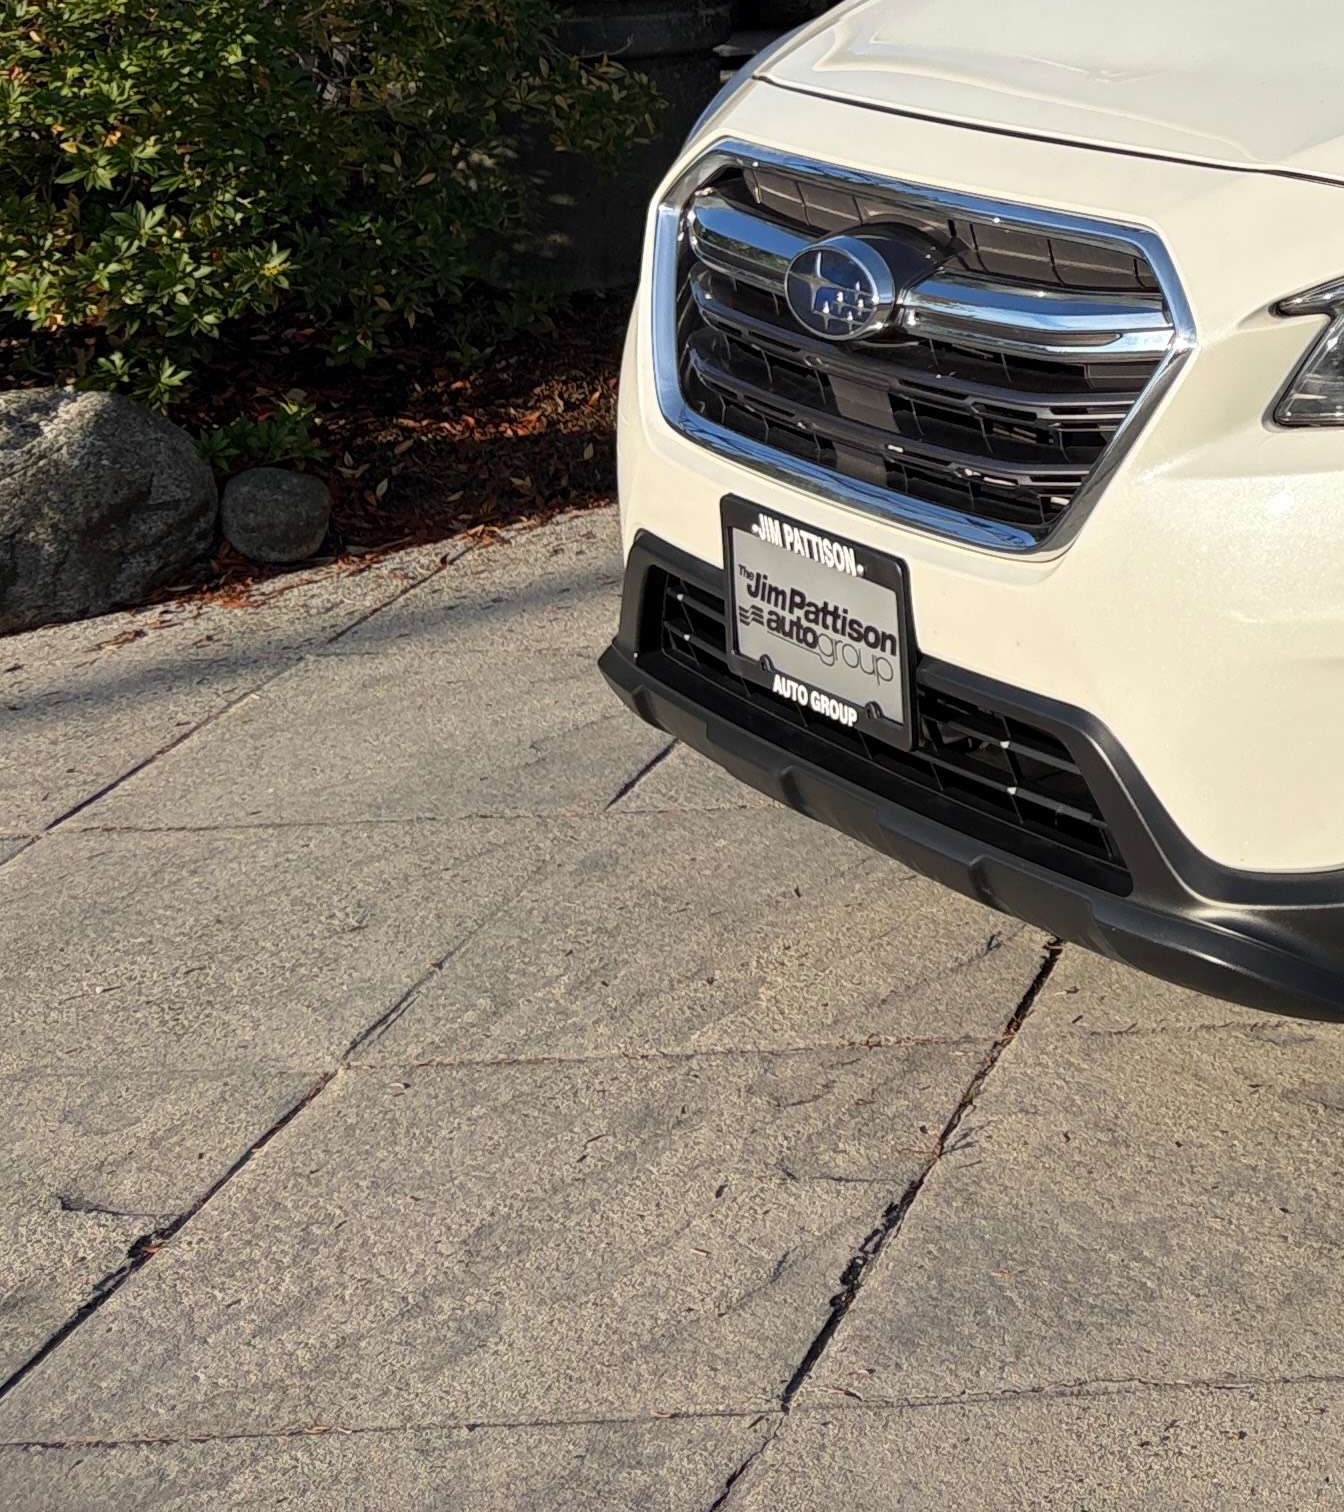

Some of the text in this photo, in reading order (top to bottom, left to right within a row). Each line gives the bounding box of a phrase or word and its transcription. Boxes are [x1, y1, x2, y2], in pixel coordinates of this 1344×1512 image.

[758, 513, 857, 577] JIM PATTISON
[738, 564, 755, 581] The
[772, 674, 858, 727] AUTO GROUP
